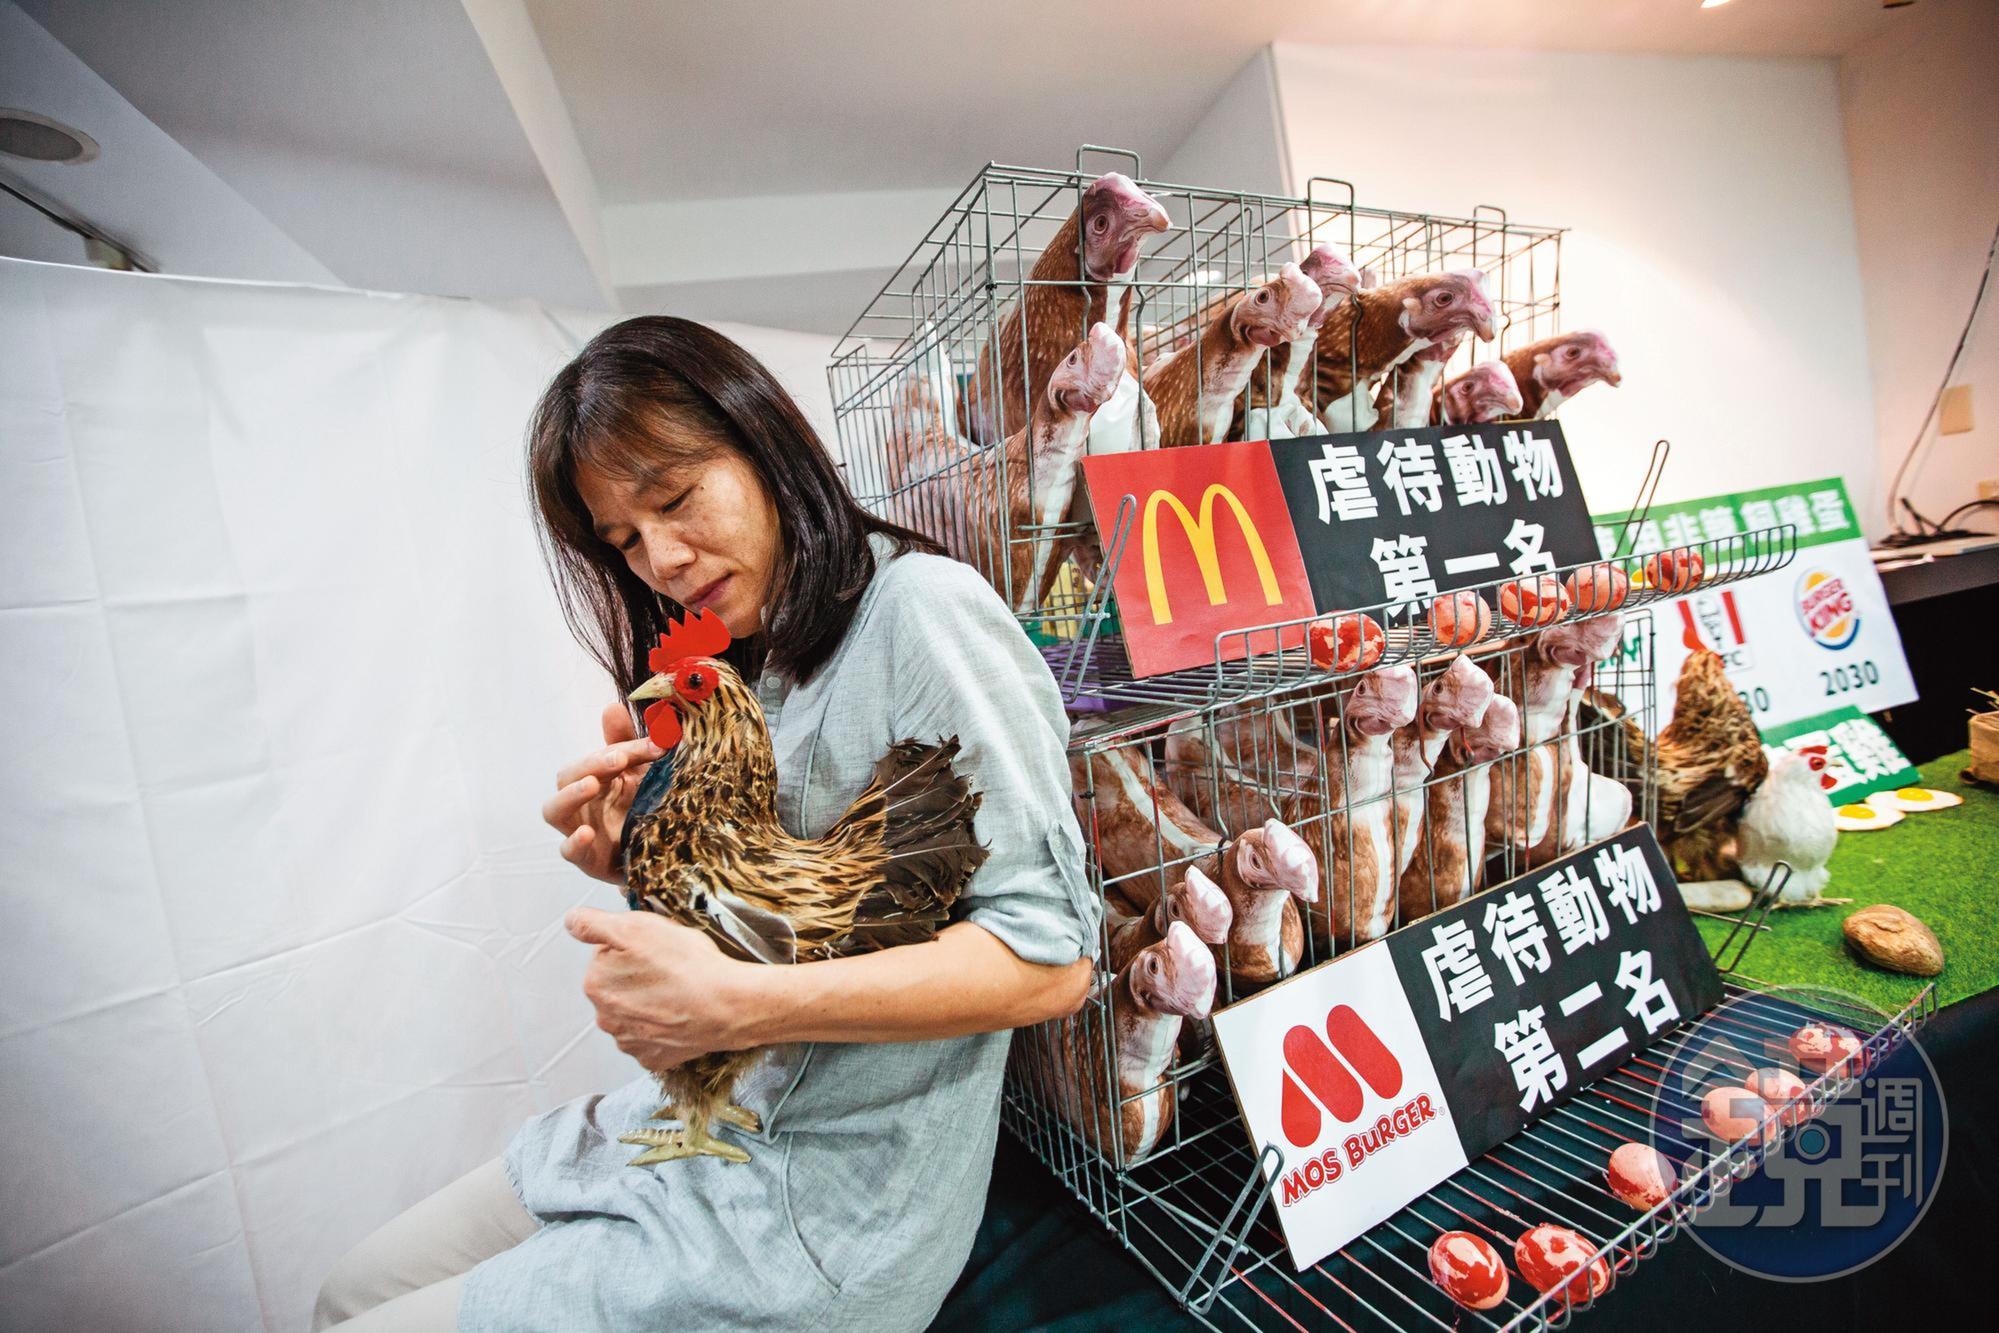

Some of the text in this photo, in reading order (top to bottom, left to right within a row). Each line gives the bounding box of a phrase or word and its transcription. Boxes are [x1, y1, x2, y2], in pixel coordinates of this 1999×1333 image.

[1307, 430, 1565, 525] 虐待動物
[1369, 518, 1557, 618] 第一名
[1819, 660, 1880, 696] 2030
[1420, 843, 1664, 1022] 虐待動物
[1493, 949, 1682, 1113] 第二名
[1281, 1148, 1343, 1206] MOS
